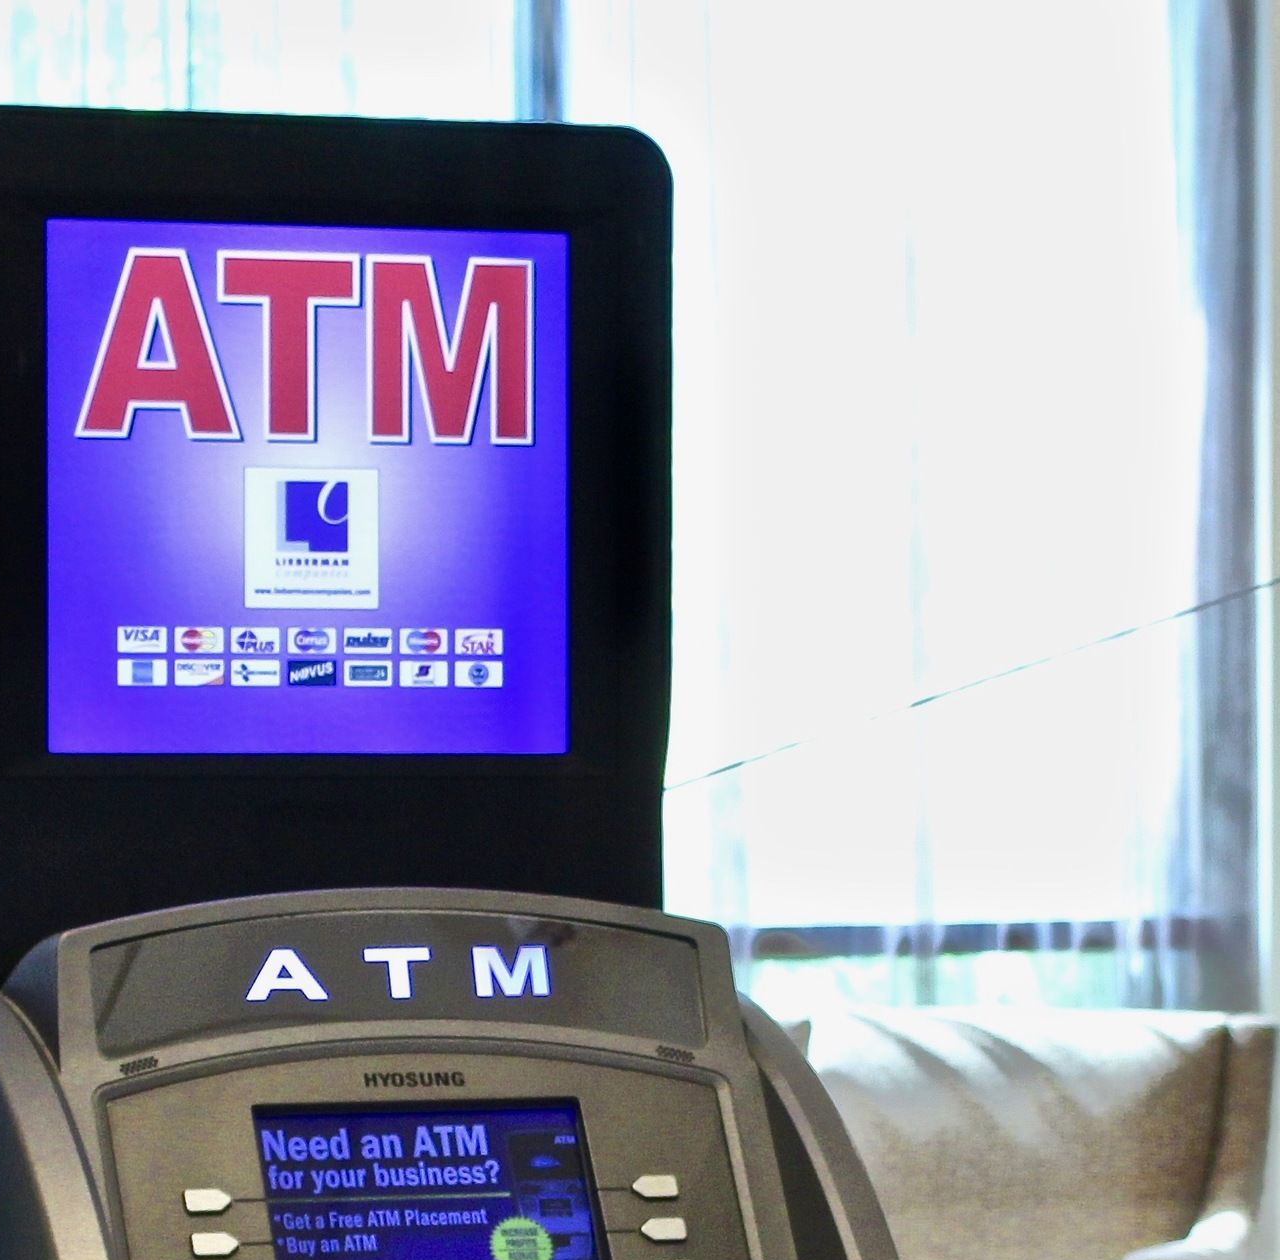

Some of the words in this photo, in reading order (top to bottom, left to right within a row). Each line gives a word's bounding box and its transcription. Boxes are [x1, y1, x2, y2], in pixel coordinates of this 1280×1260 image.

[74, 247, 535, 446] ATM
[123, 629, 160, 641] VISA
[245, 640, 275, 652] PLUS
[462, 637, 495, 654] STAR
[246, 945, 552, 1001] ATM
[364, 1072, 465, 1087] HYOSUNG
[261, 1128, 351, 1161] Need
[361, 1133, 403, 1160] an
[413, 1125, 489, 1157] ATM
[268, 1164, 303, 1190] for
[311, 1167, 367, 1194] your
[373, 1160, 500, 1187] business?
[283, 1212, 311, 1230] Get
[315, 1217, 325, 1229] a
[328, 1211, 363, 1228] Free
[367, 1210, 401, 1227] ATM
[405, 1208, 488, 1226] Placement
[286, 1236, 316, 1256] Buy
[321, 1238, 340, 1252] an
[344, 1234, 378, 1251] ATM
